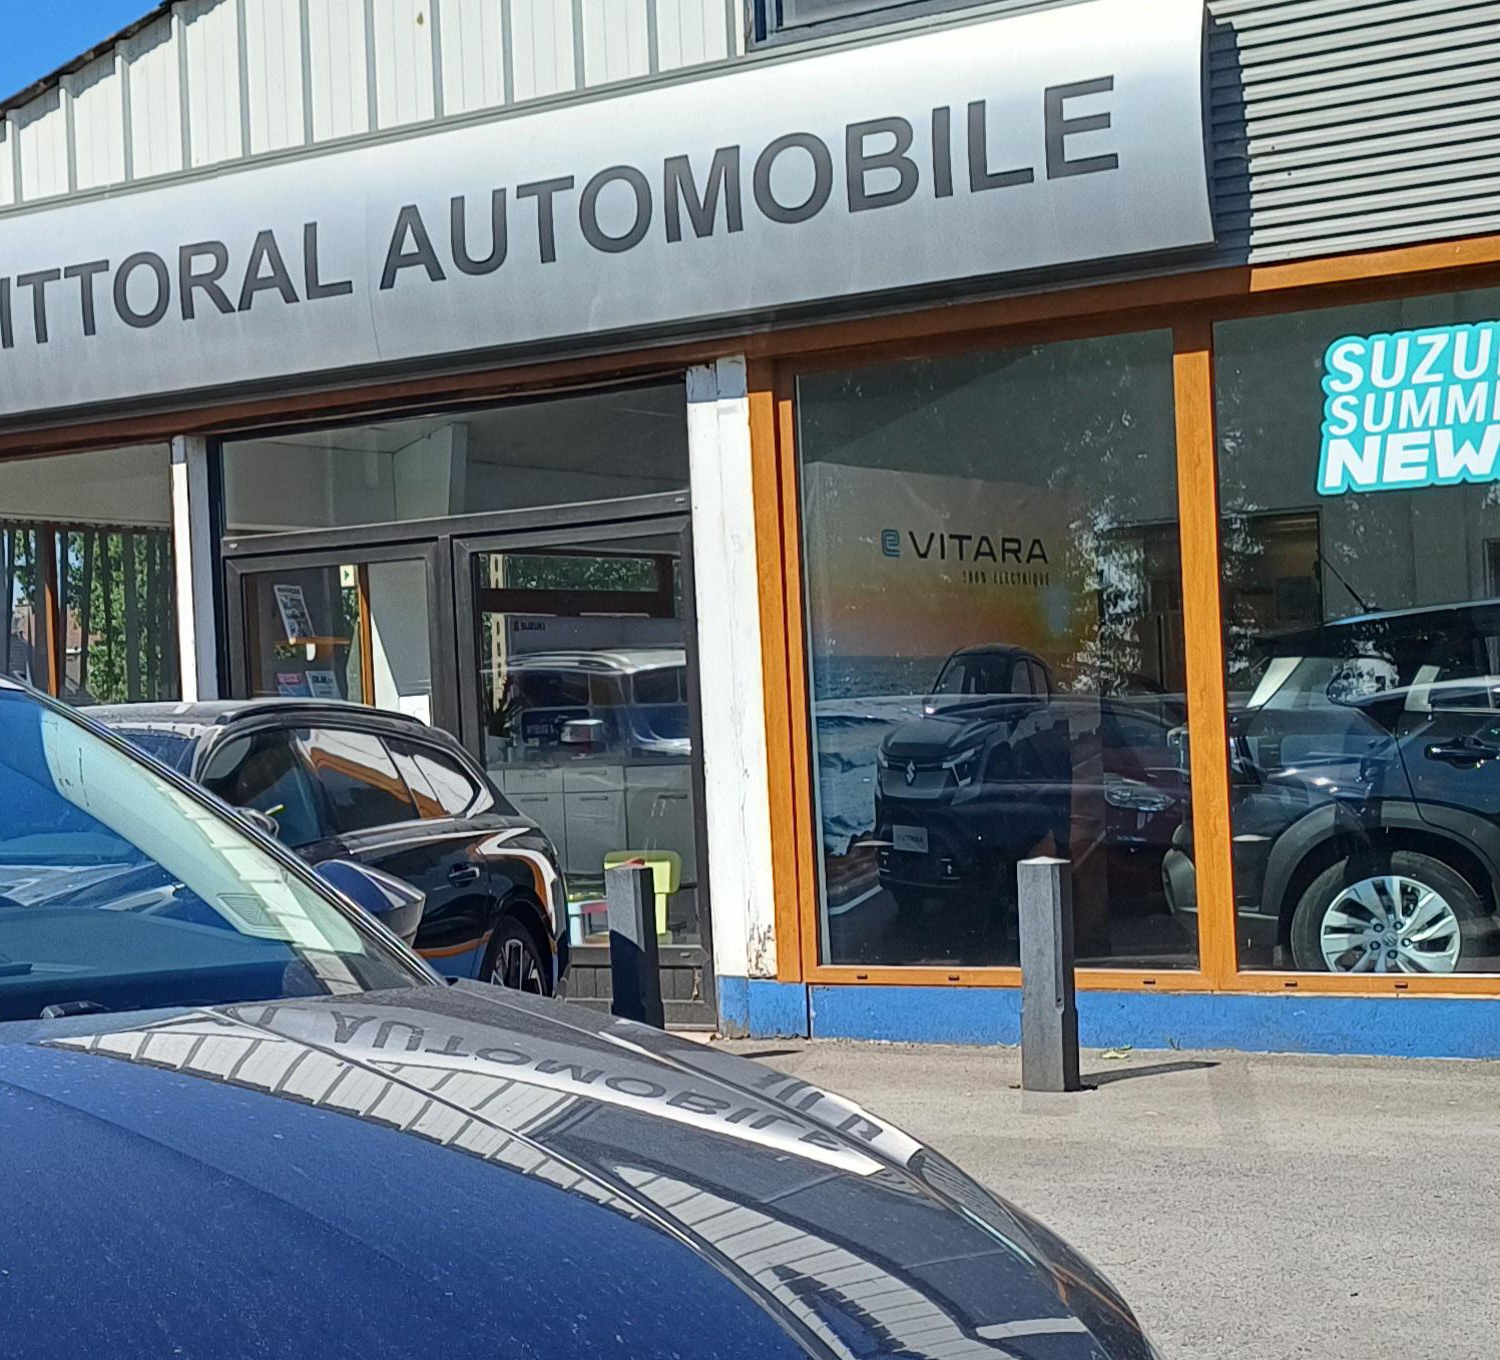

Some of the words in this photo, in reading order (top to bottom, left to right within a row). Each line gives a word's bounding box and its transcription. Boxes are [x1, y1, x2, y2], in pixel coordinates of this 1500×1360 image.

[379, 74, 1118, 291] AUTOMOBILE
[1329, 328, 1500, 392] SUZU
[908, 530, 1049, 564] VITARA
